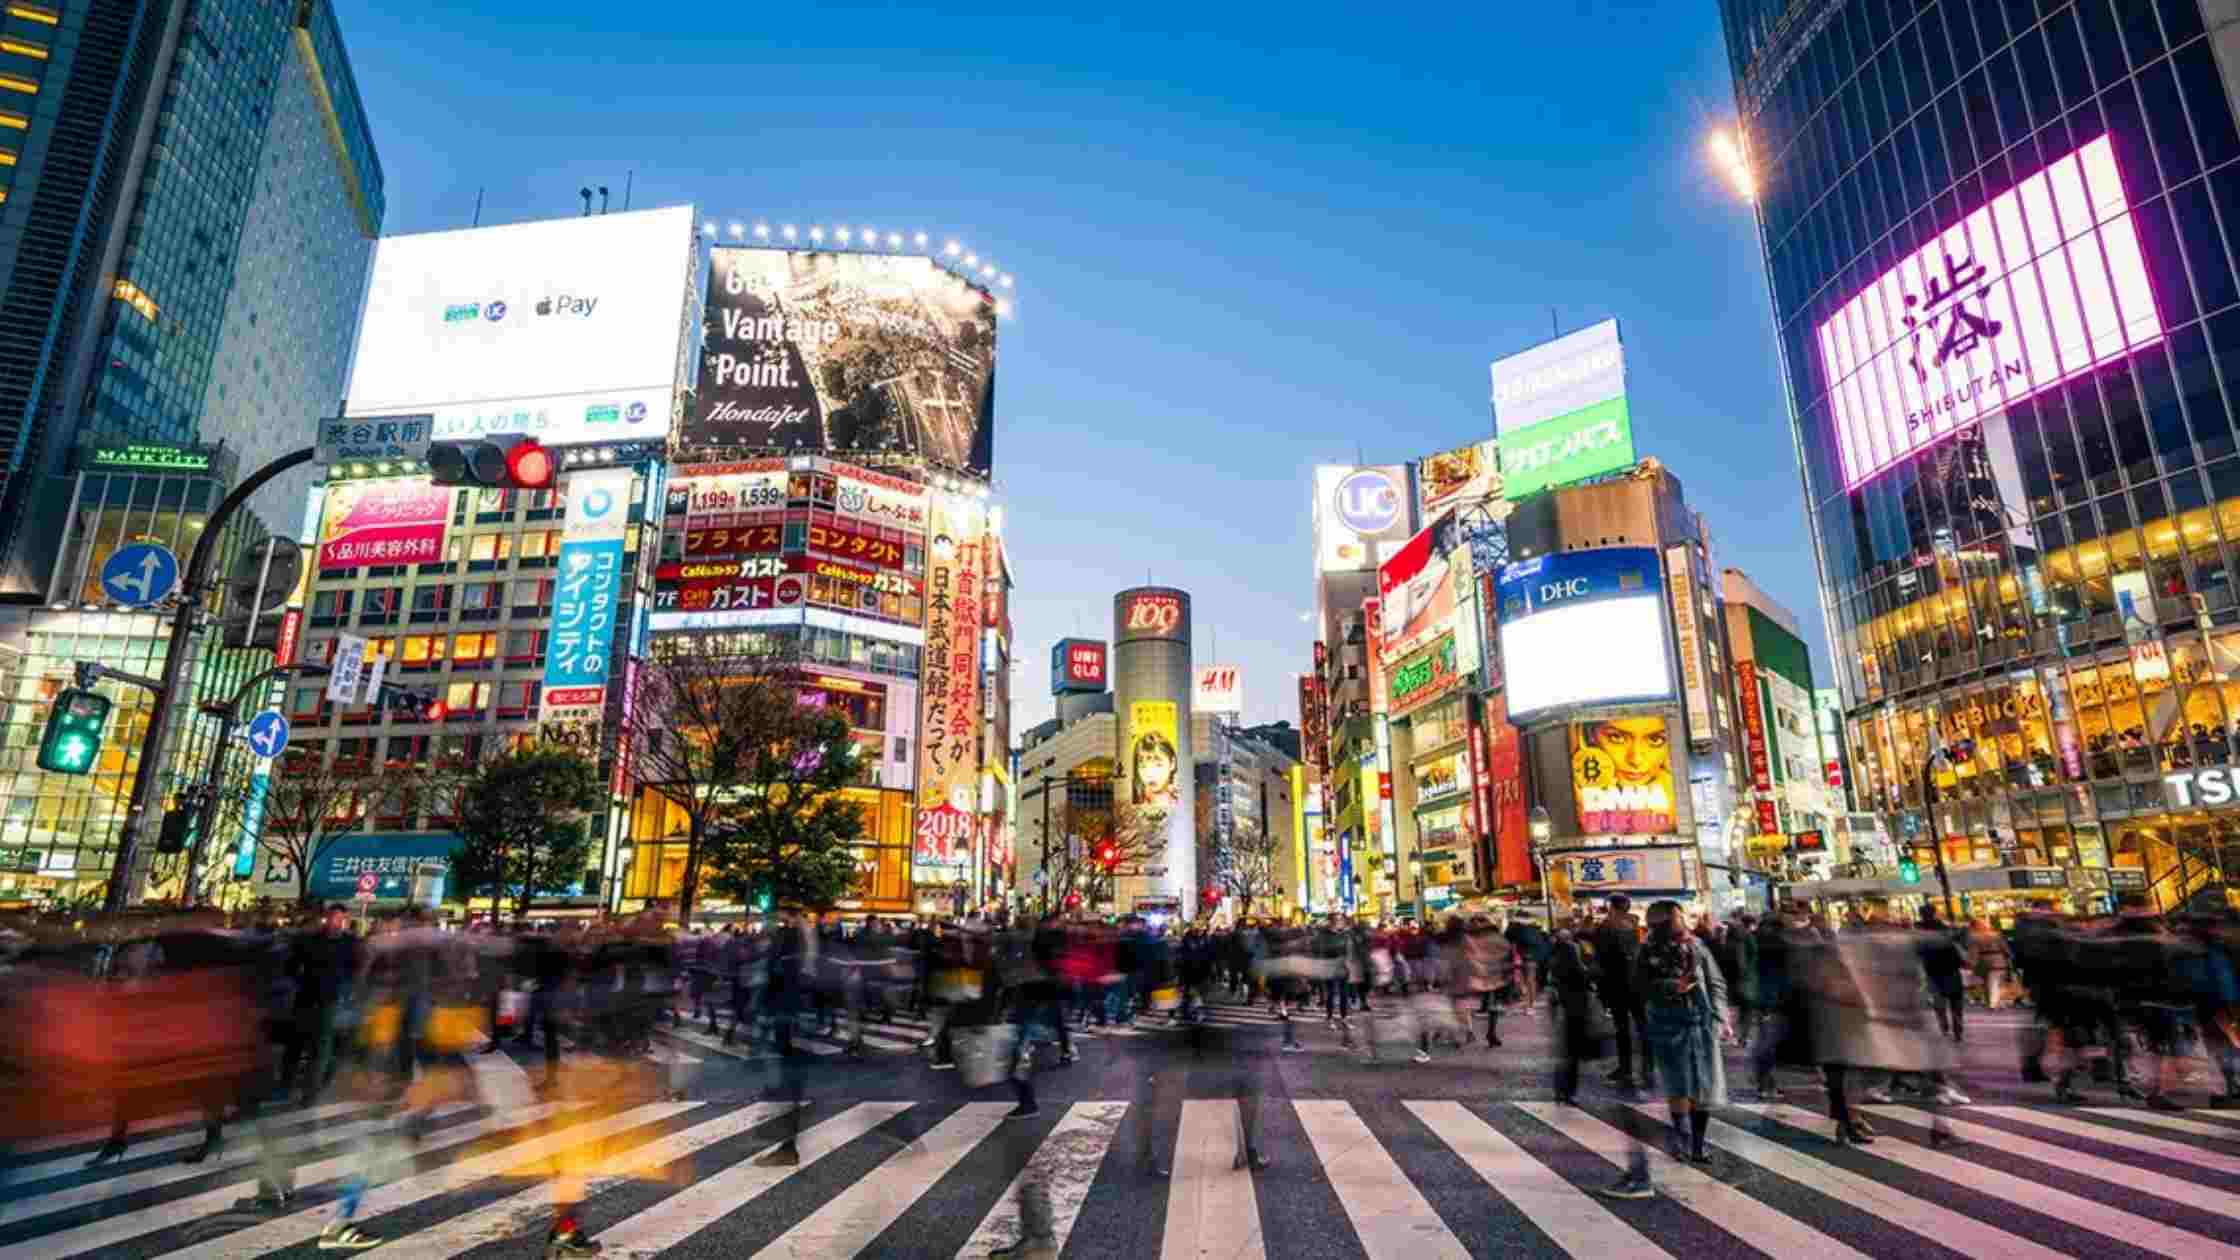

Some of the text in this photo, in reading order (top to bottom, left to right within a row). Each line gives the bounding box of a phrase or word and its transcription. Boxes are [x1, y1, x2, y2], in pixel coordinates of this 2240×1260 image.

[556, 295, 598, 317] Pay
[722, 307, 839, 345] Vantage
[1900, 253, 2003, 386] 渋
[716, 353, 799, 388] Point.
[1908, 359, 2023, 431] SHIBUTAN
[705, 400, 810, 430] HondaJet
[326, 420, 426, 445] 渋谷駅前
[96, 450, 209, 467] MARK CITY
[336, 537, 436, 561] 品川美容外科
[810, 527, 901, 562] コンタクト
[740, 556, 788, 578] ガスト
[872, 571, 917, 595] ガスト
[1540, 577, 1588, 601] DHC
[656, 590, 680, 607] 7F
[710, 585, 768, 609] ガスト
[583, 552, 614, 673] コンタクトの
[1127, 603, 1179, 634] 109
[1073, 650, 1098, 663] UNI
[925, 566, 952, 776] 日本武道館だって。
[1073, 664, 1100, 678] QLO
[917, 809, 971, 837] 2018
